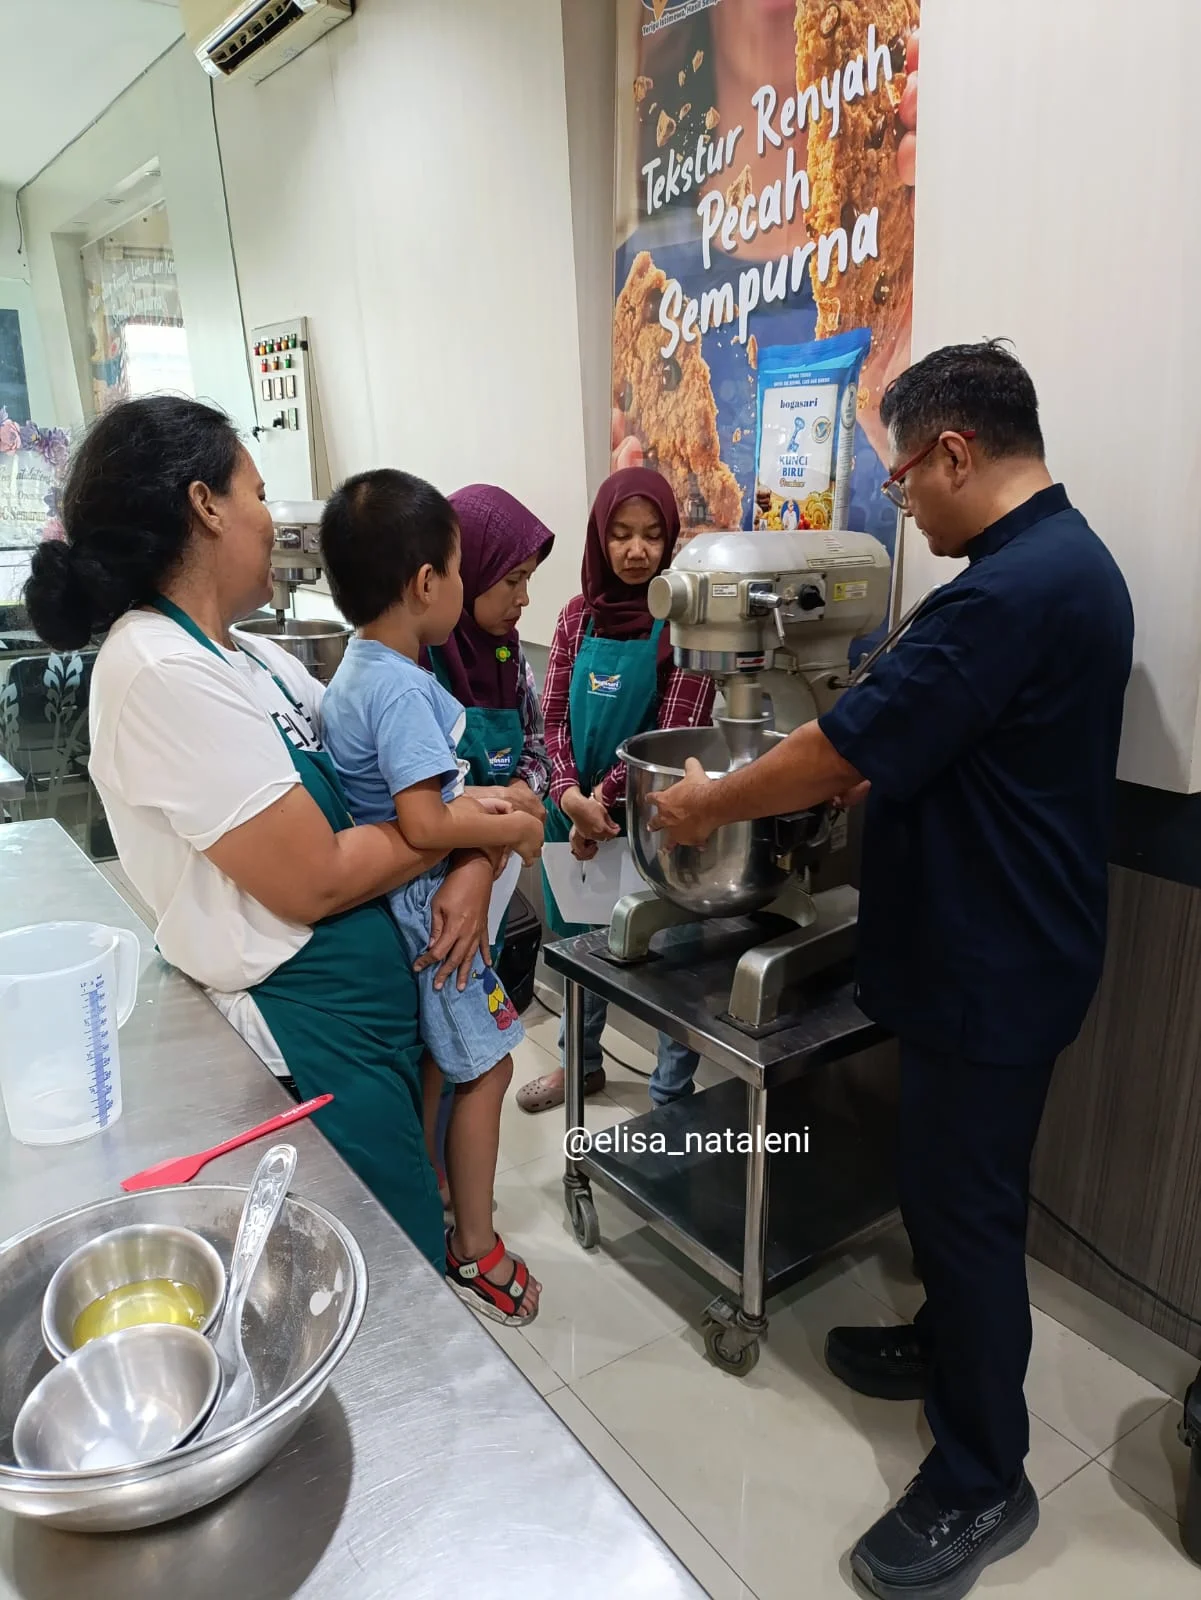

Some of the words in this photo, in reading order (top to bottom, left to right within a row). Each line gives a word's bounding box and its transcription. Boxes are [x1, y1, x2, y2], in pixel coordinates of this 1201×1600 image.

[641, 124, 744, 216] Tekstur
[751, 24, 892, 154] Renyah
[696, 147, 811, 270] Pecah
[658, 207, 879, 360] Sempurna
[780, 397, 818, 410] bogasari
[779, 455, 808, 466] KUNCI
[782, 467, 804, 477] BIRU
